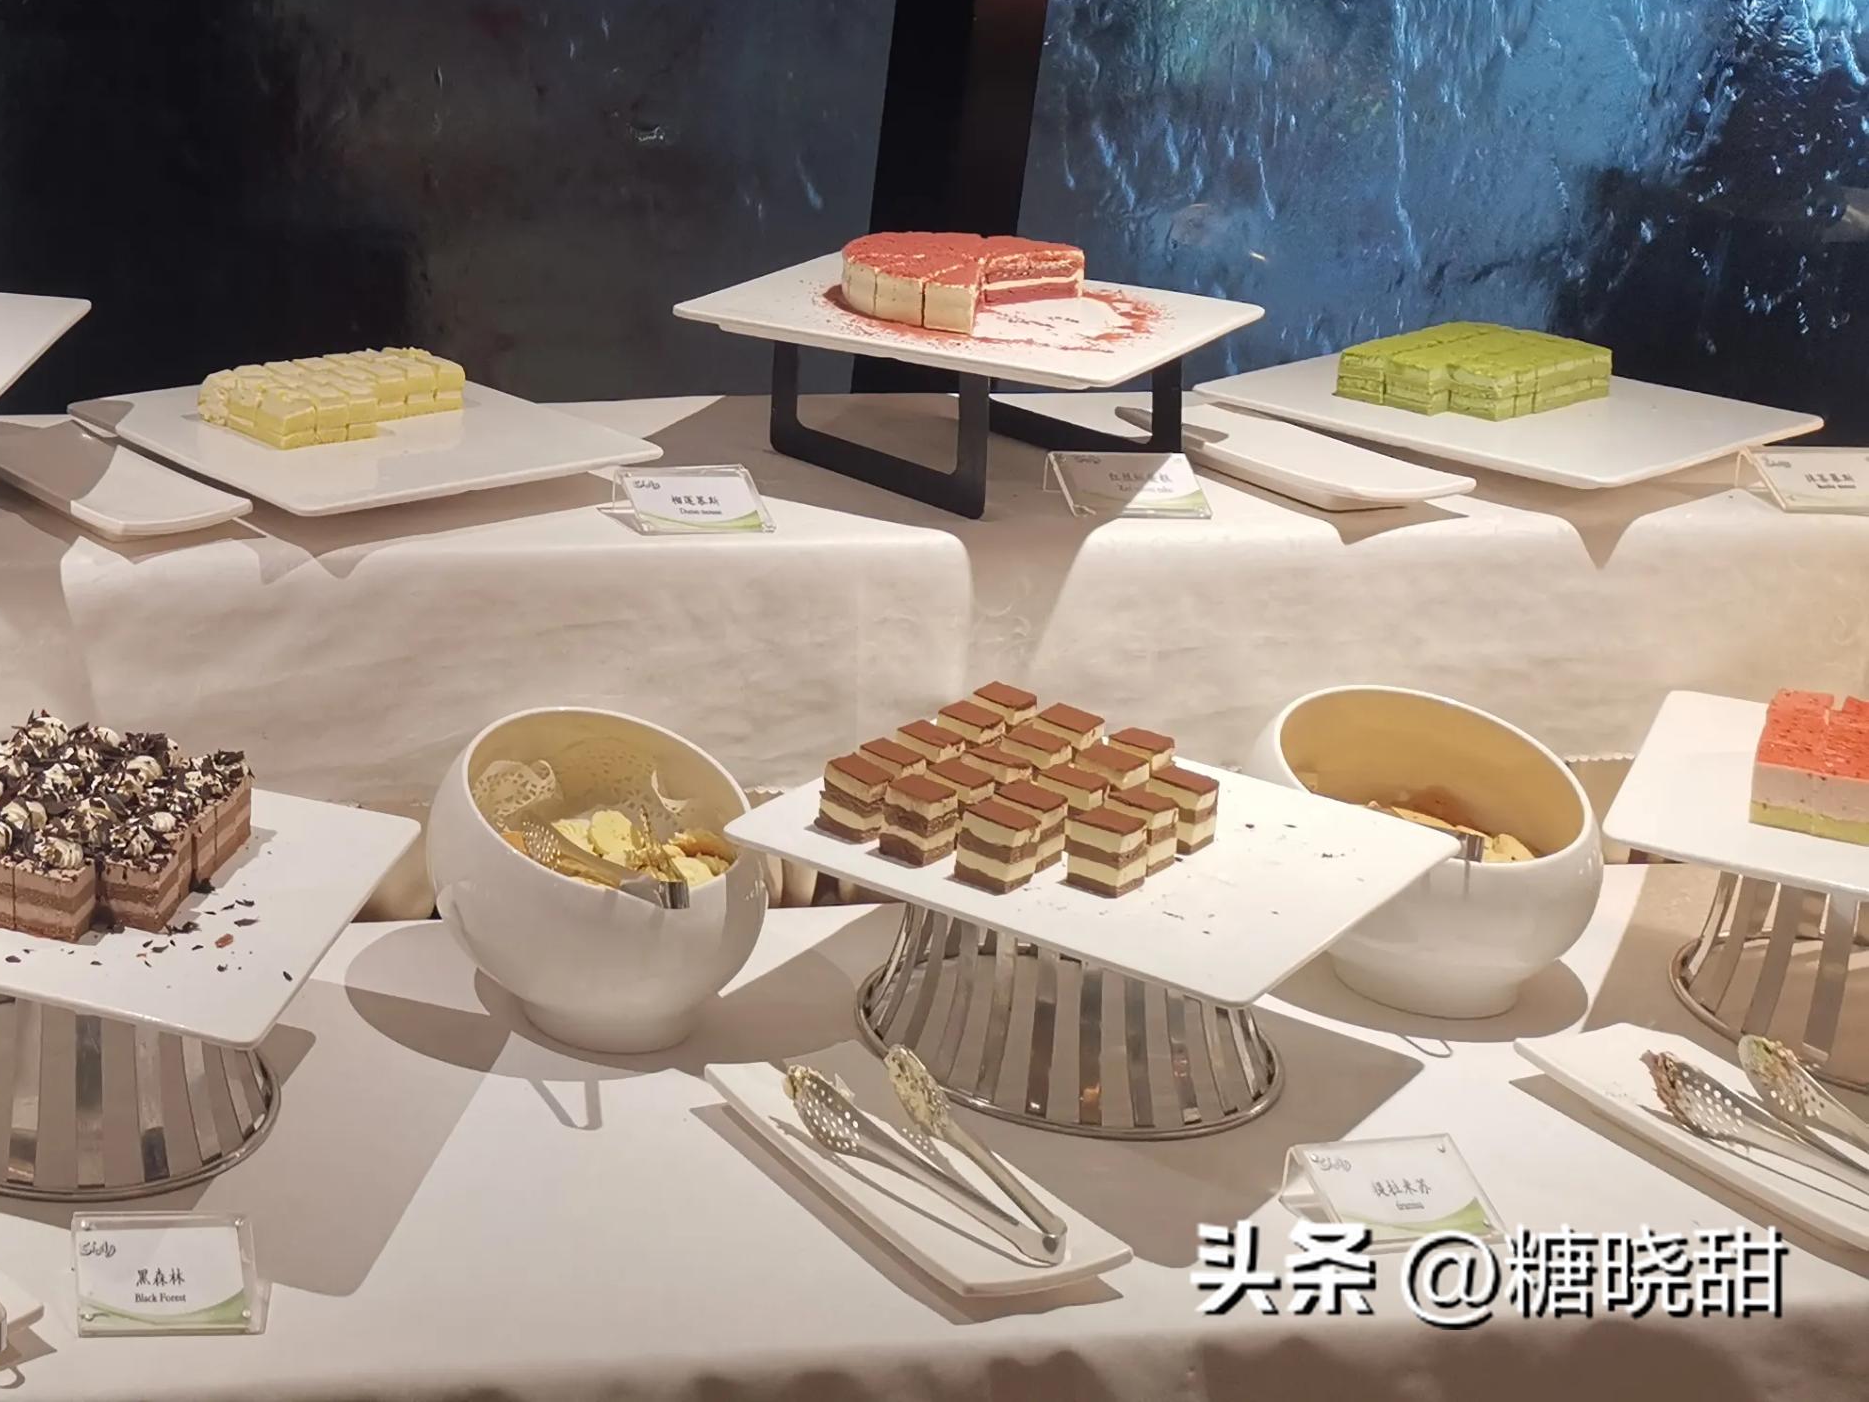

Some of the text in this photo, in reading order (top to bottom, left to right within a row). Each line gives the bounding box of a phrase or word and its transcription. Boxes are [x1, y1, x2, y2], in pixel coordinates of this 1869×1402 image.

[1371, 1178, 1432, 1197] 提拉米苏
[135, 1267, 186, 1287] 黑森林
[134, 1292, 187, 1303] Black Forest
